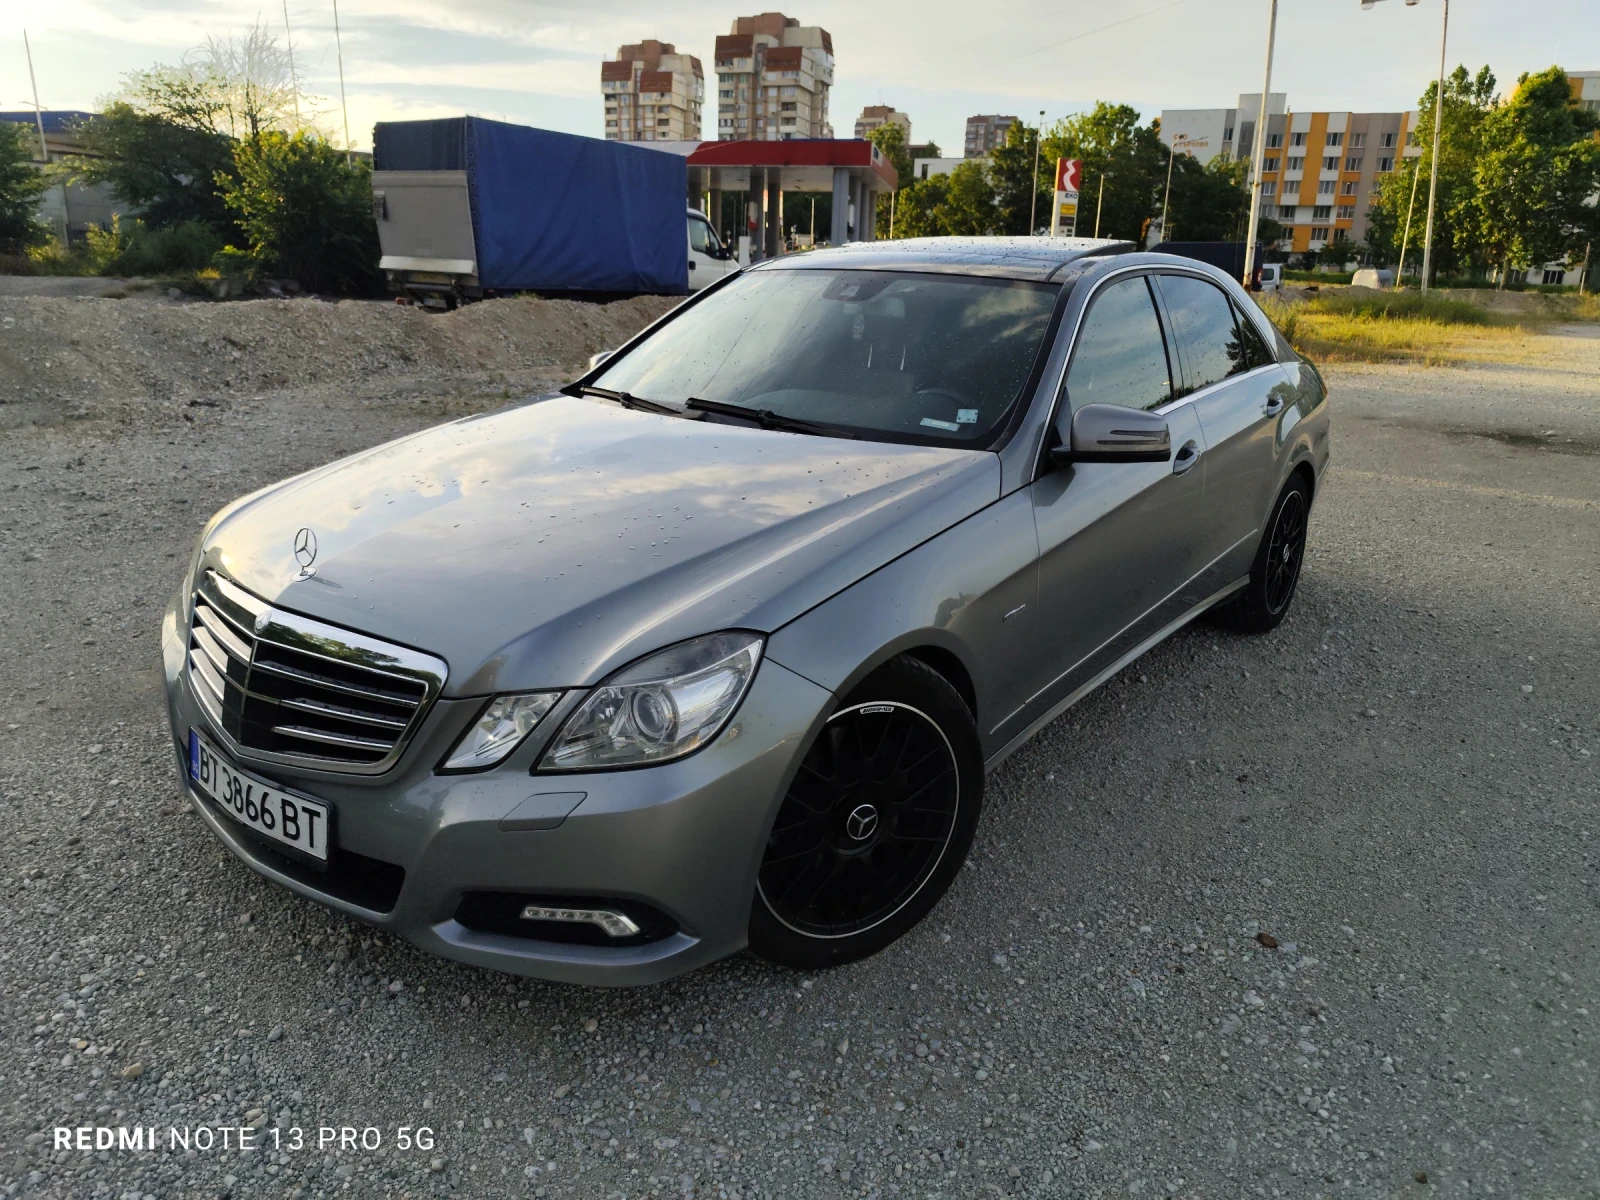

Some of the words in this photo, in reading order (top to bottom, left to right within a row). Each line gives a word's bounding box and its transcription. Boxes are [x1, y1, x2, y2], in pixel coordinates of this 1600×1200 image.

[1064, 192, 1078, 200] EKO
[222, 766, 276, 830] 3866
[281, 797, 321, 849] BT
